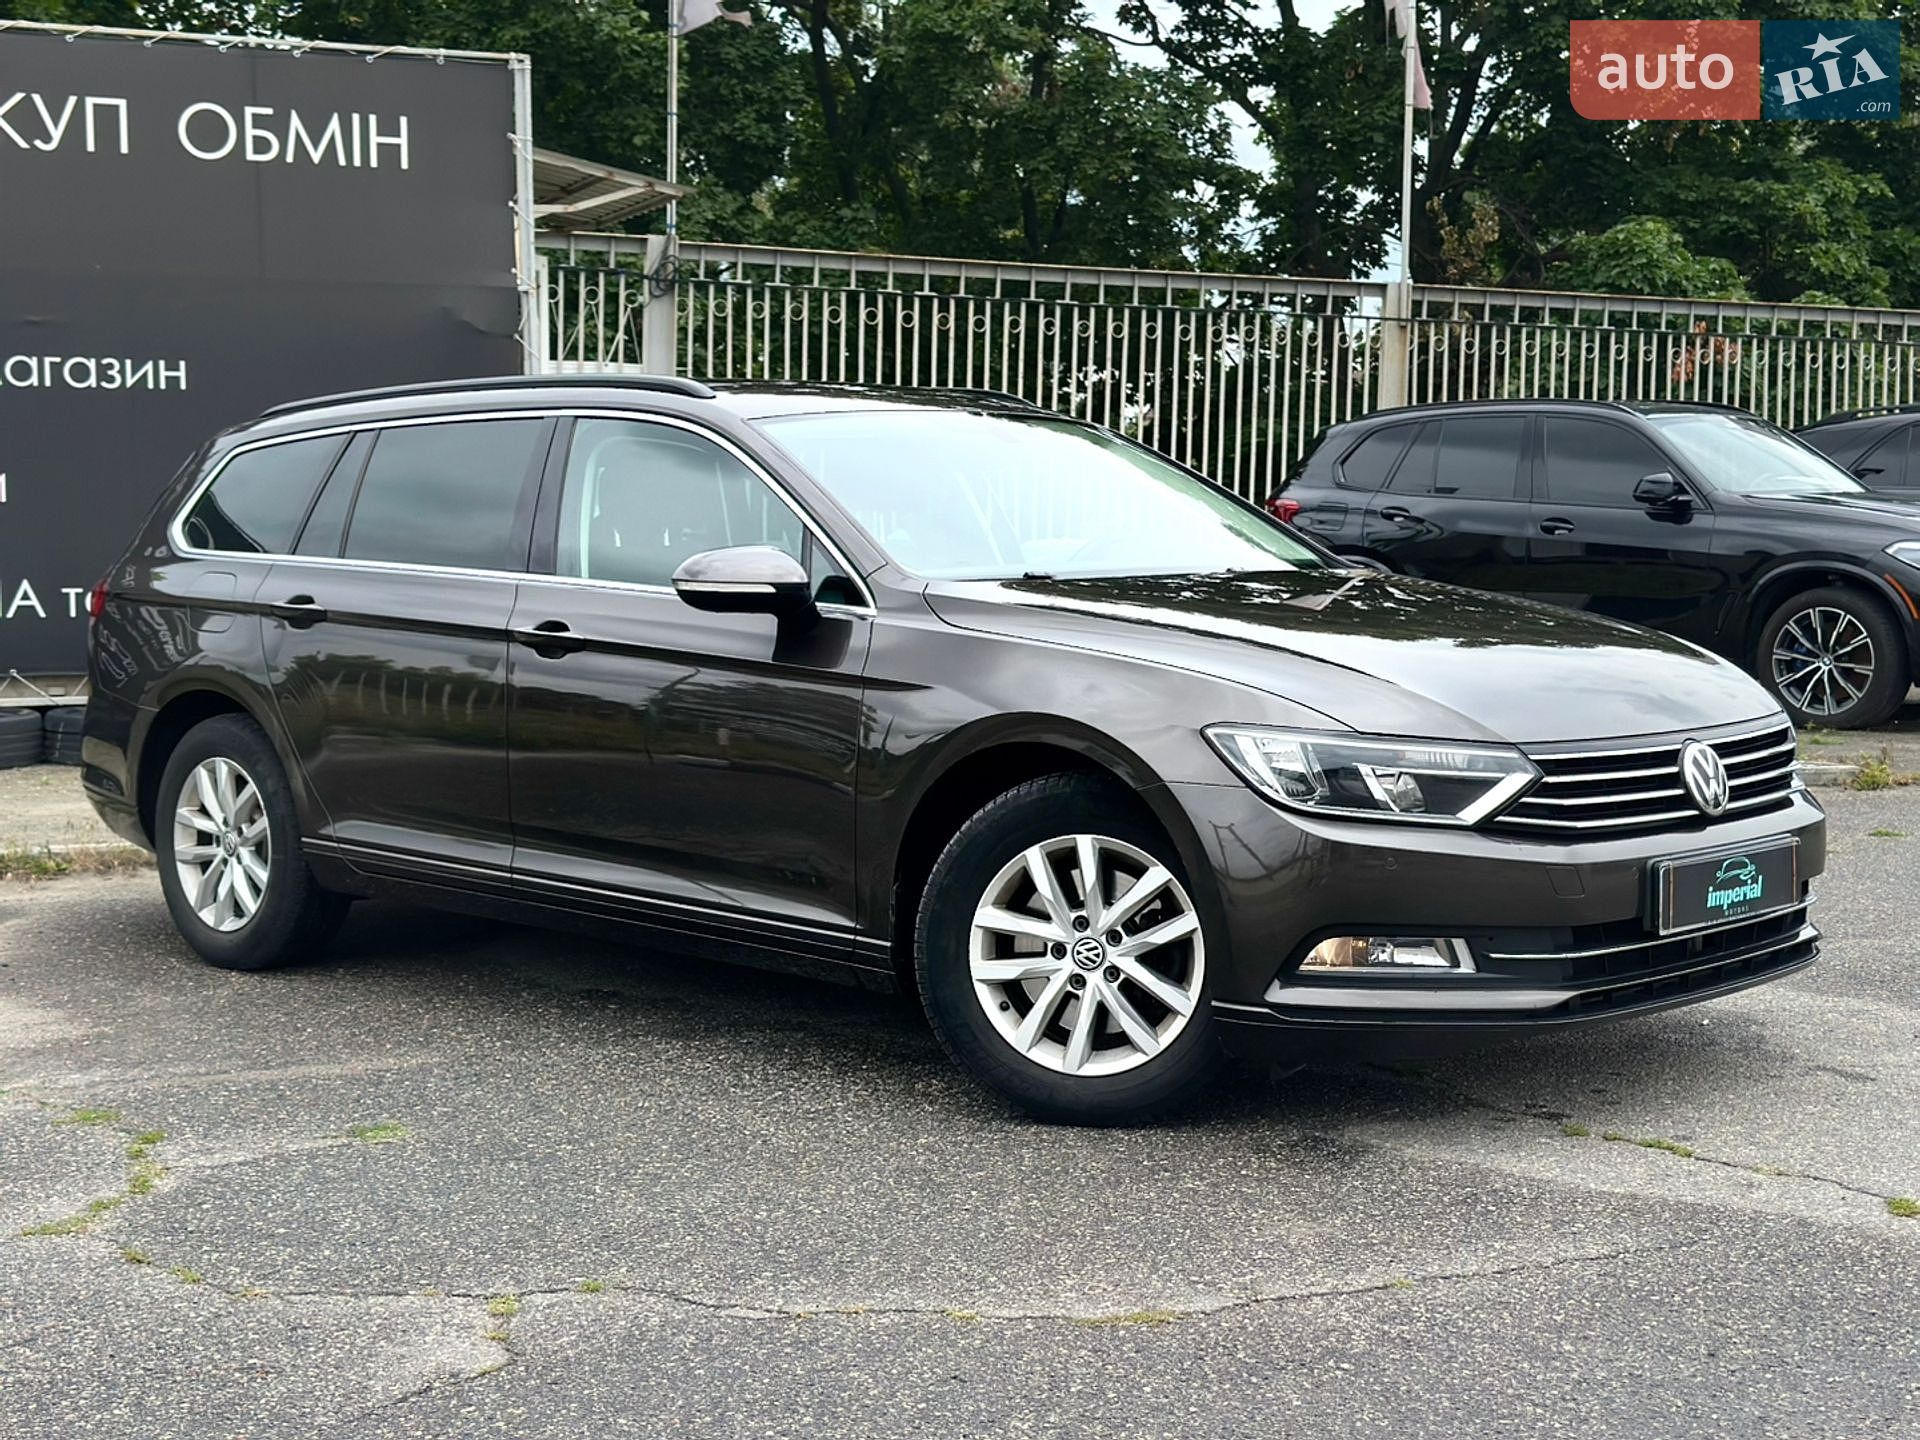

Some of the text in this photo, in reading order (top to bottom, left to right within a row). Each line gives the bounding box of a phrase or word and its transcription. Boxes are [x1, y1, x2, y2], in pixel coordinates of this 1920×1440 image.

[177, 102, 409, 170] ОБМІН
[0, 355, 187, 391] агазин
[0, 578, 47, 618] А
[1706, 875, 1763, 910] imperial
